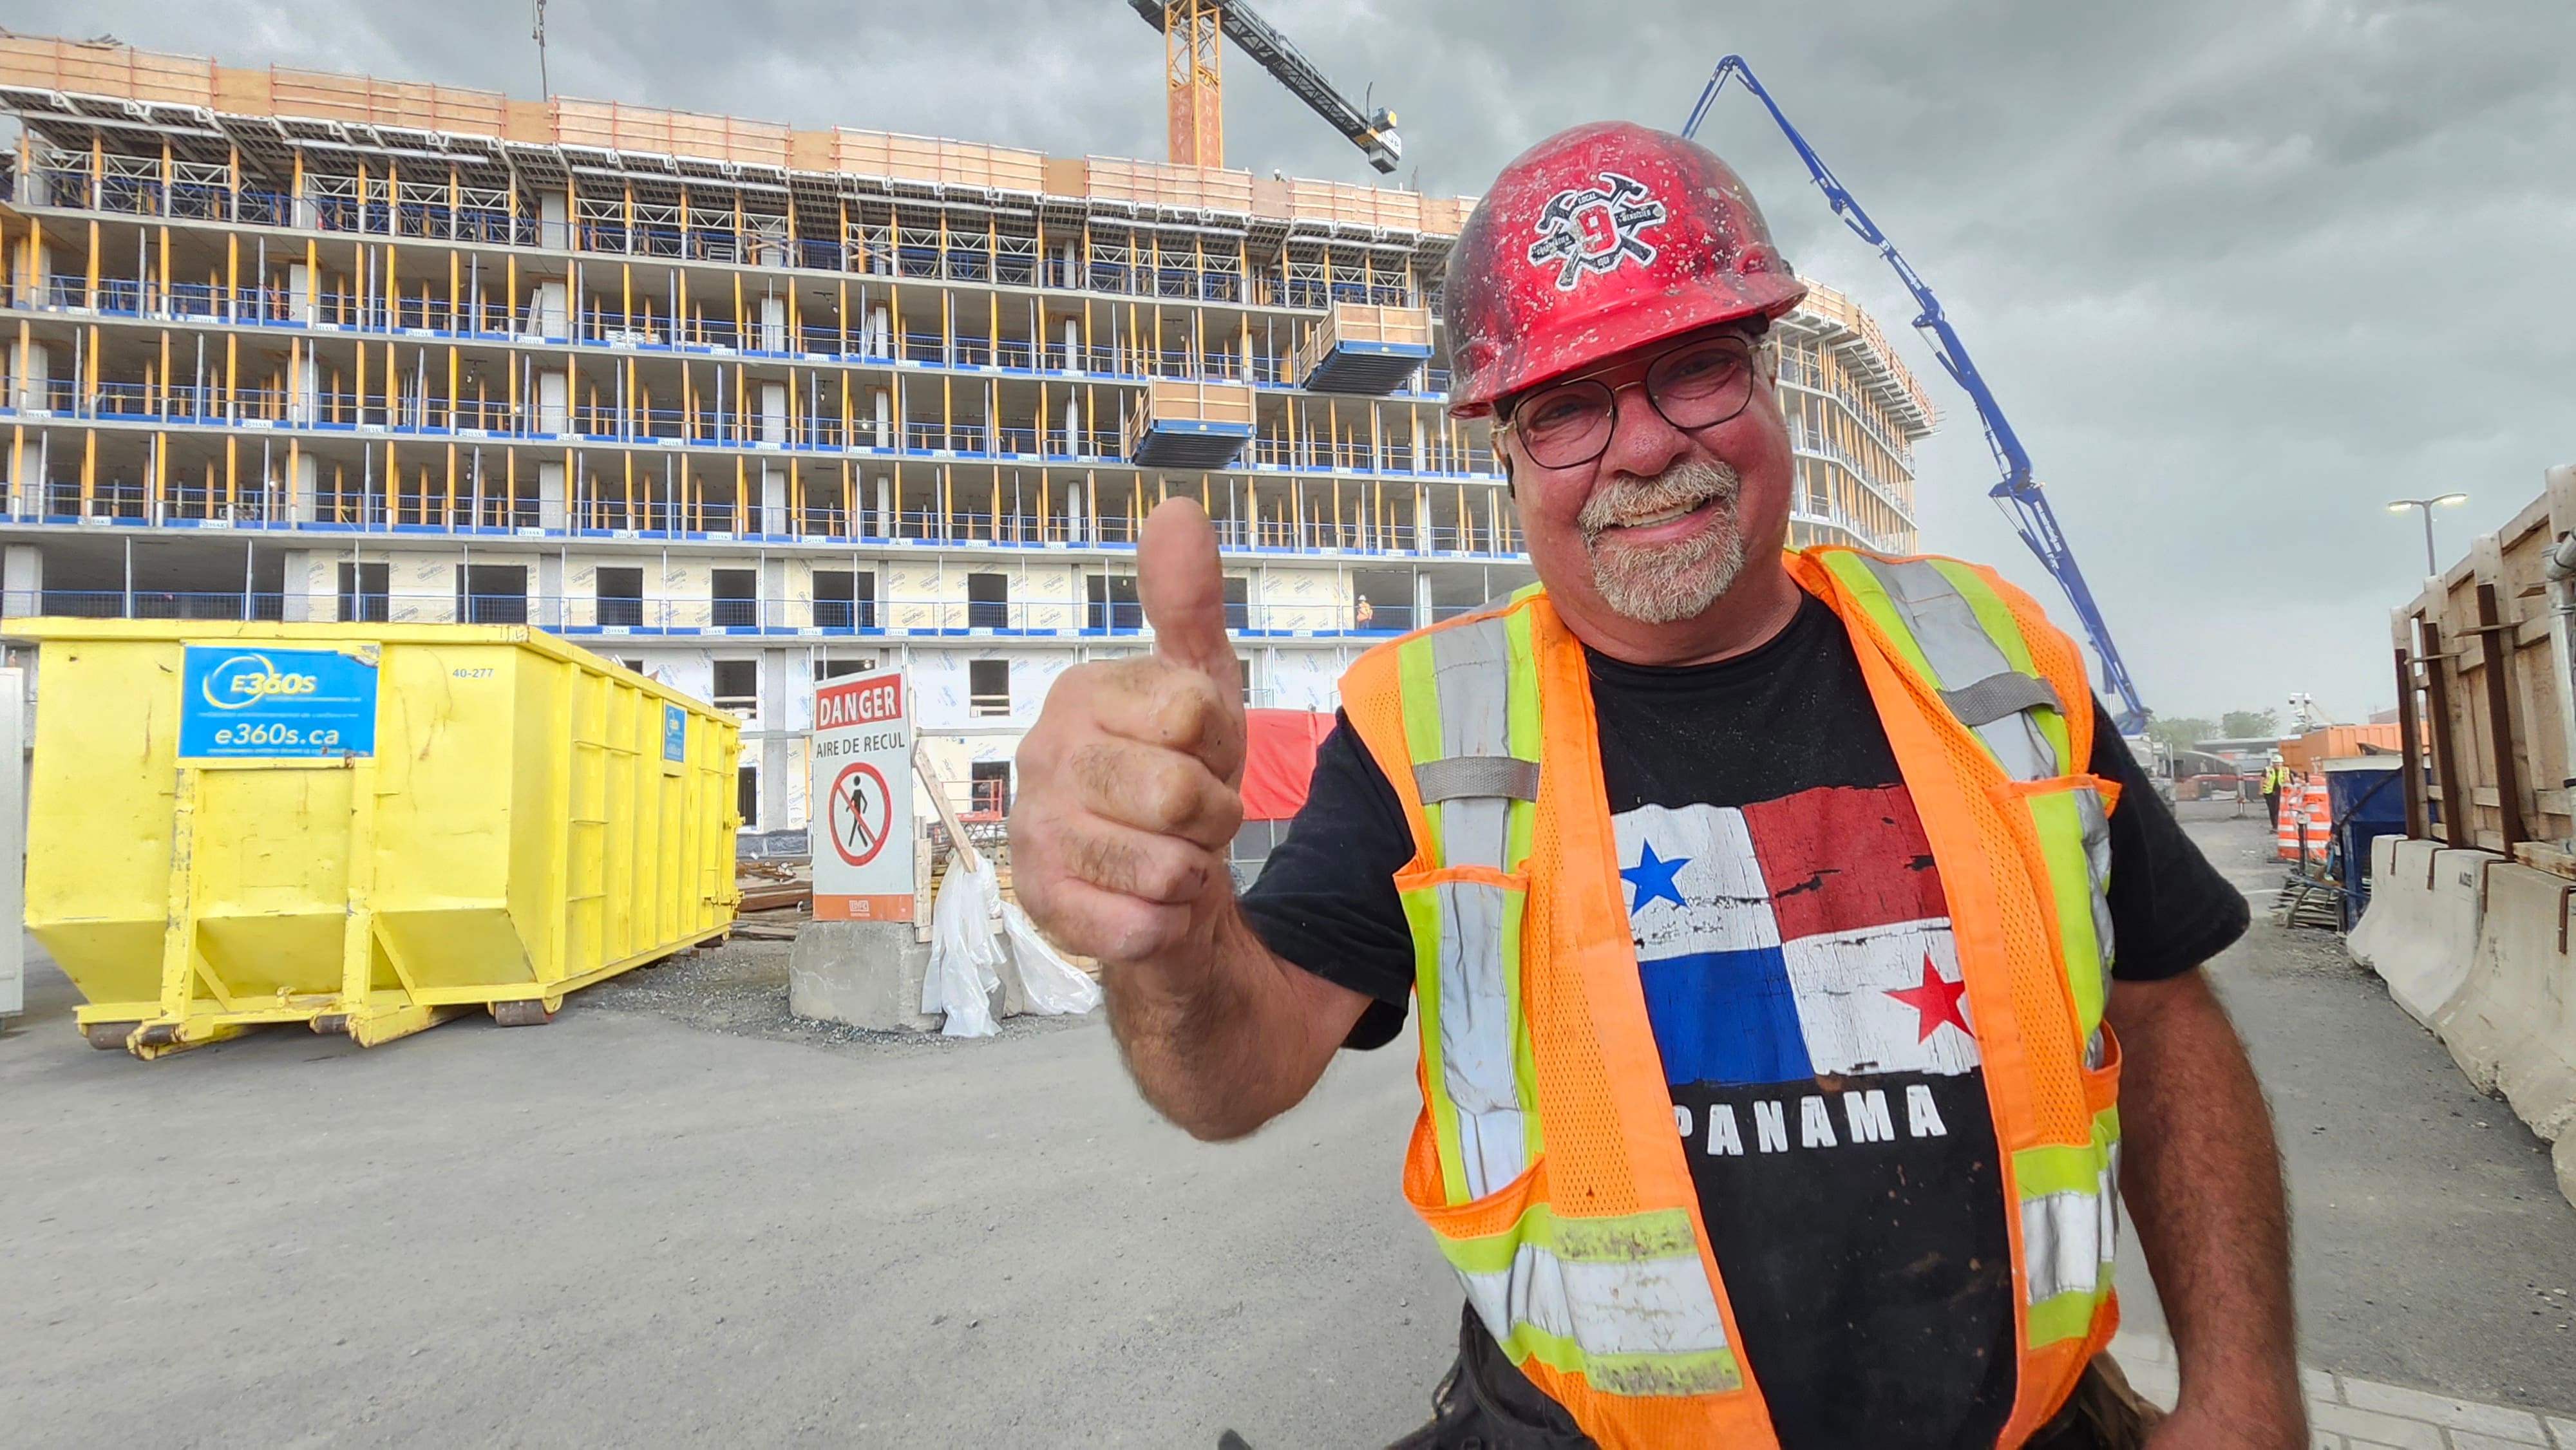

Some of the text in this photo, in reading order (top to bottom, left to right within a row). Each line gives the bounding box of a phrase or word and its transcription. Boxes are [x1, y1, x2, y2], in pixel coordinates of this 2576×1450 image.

[453, 668, 494, 678] 40-277
[819, 685, 897, 726] DANGER
[214, 723, 340, 745] e360s.ca
[816, 731, 905, 758] AIRE DE RECUL
